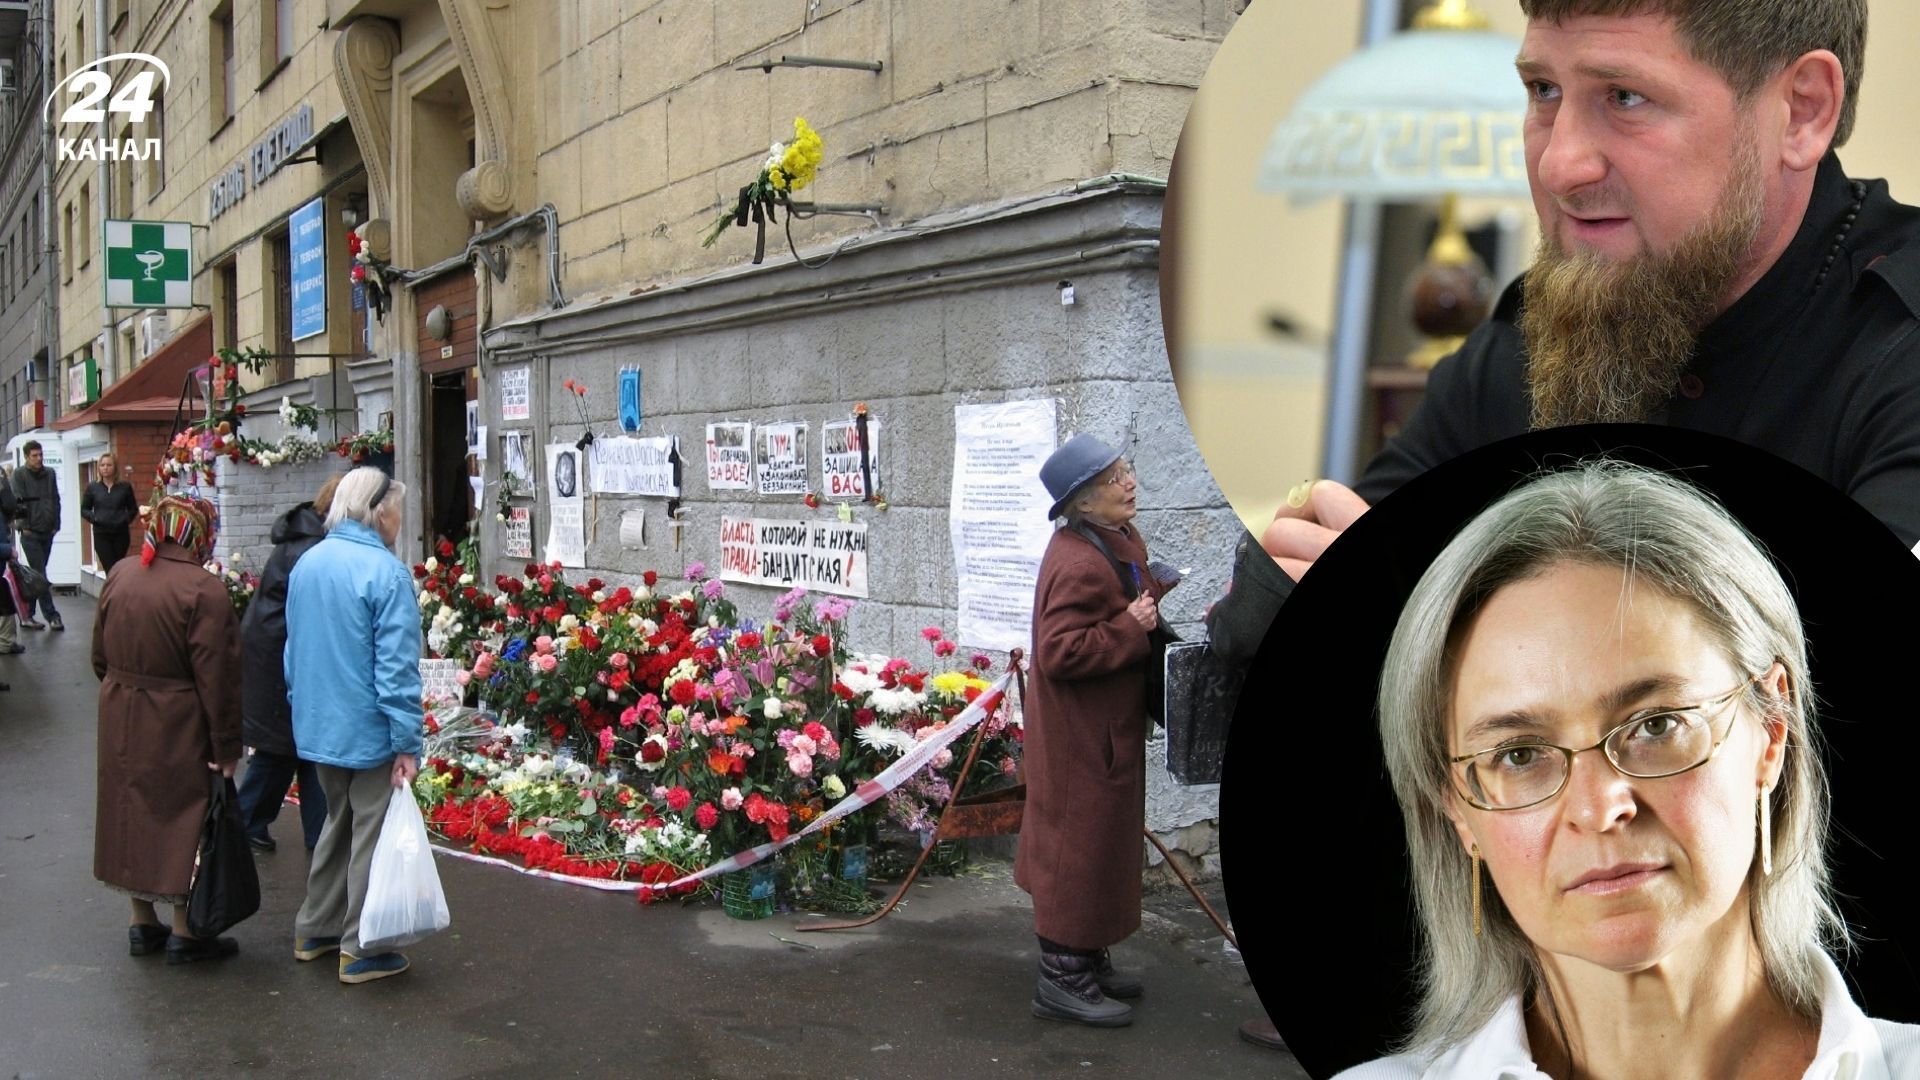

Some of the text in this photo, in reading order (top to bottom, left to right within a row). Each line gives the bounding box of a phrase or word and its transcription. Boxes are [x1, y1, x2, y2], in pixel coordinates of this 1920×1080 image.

[710, 466, 722, 480] ЗА
[824, 456, 877, 476] ЗАЩИЩАА
[832, 474, 862, 494] ВАС
[761, 521, 807, 547] КОТОРОЙ
[813, 528, 826, 549] НЕ
[829, 529, 866, 552] НУЖНА
